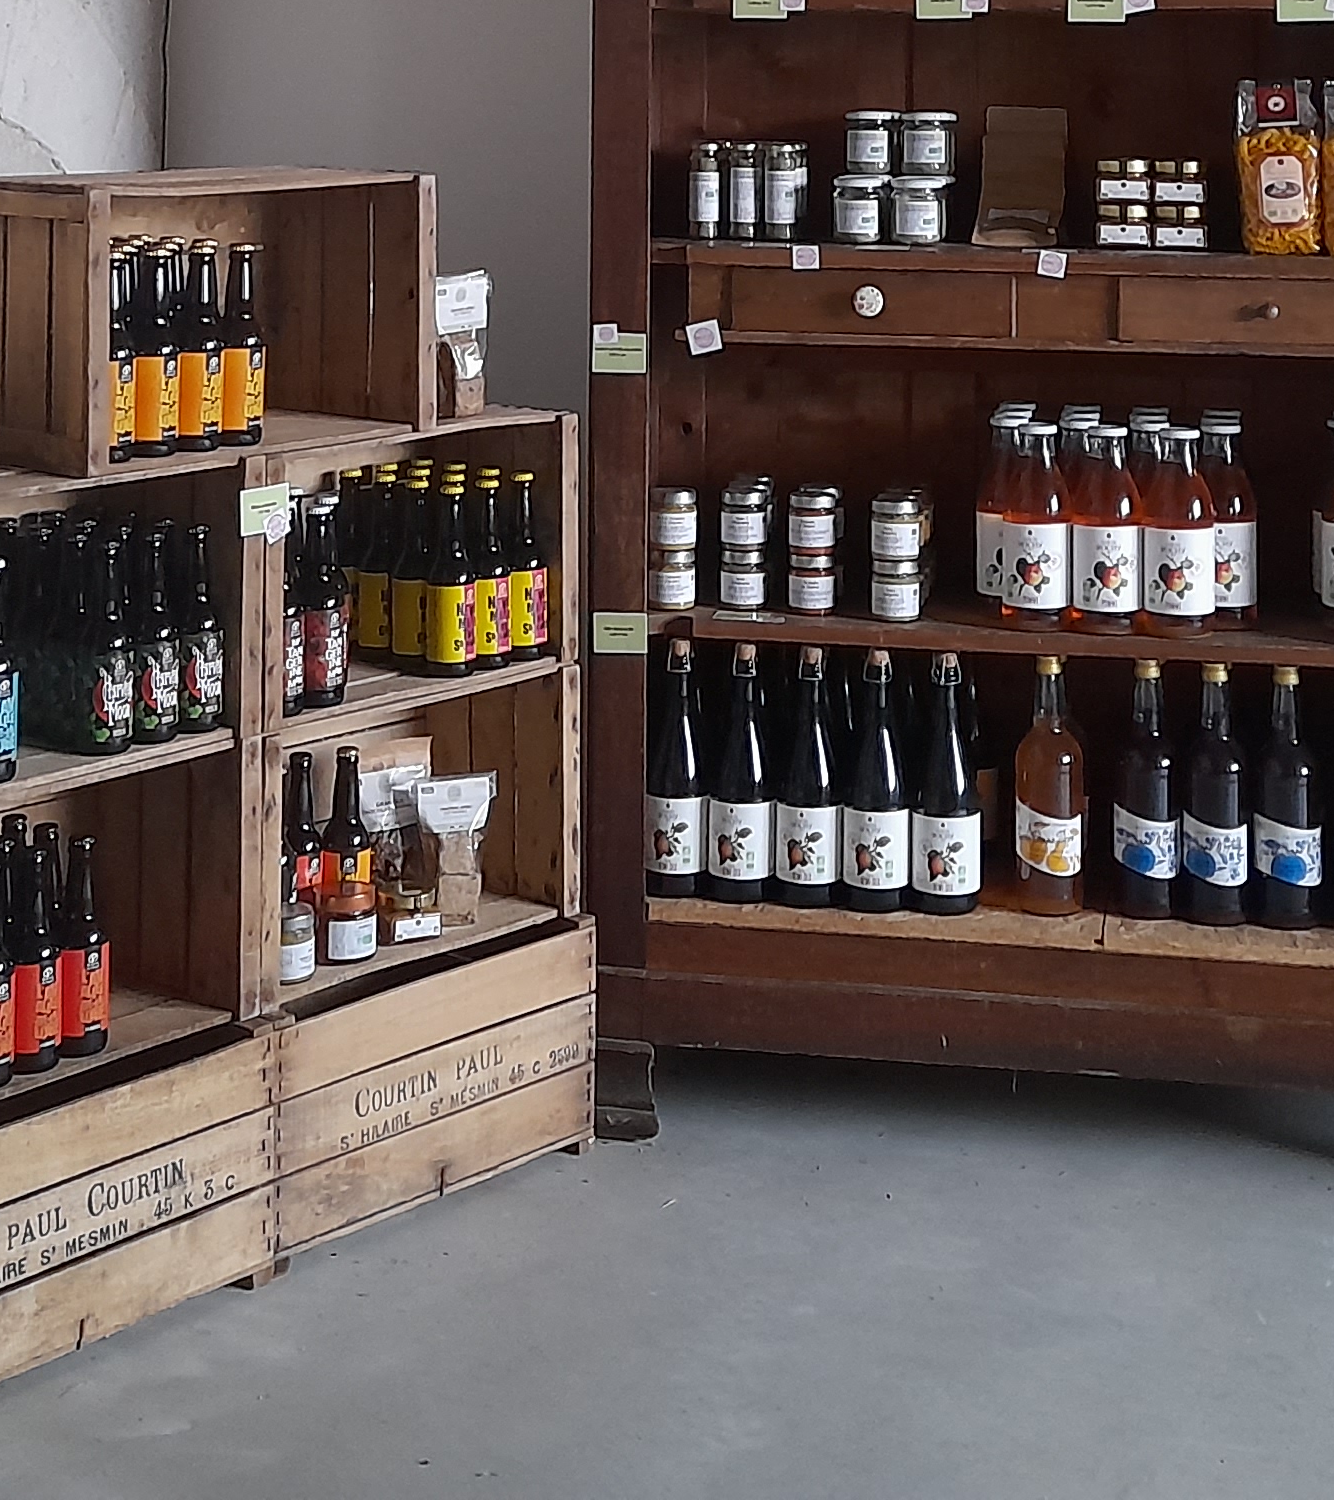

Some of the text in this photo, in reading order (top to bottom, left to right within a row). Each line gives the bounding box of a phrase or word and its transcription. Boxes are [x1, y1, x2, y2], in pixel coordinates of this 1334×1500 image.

[455, 1044, 503, 1081] PAUL
[360, 1110, 412, 1145] HILAIRE
[6, 1205, 68, 1251] PAUL
[65, 1217, 129, 1258] MESMIN
[153, 1196, 174, 1220] 45
[184, 1191, 195, 1210] K
[203, 1178, 215, 1201] 3
